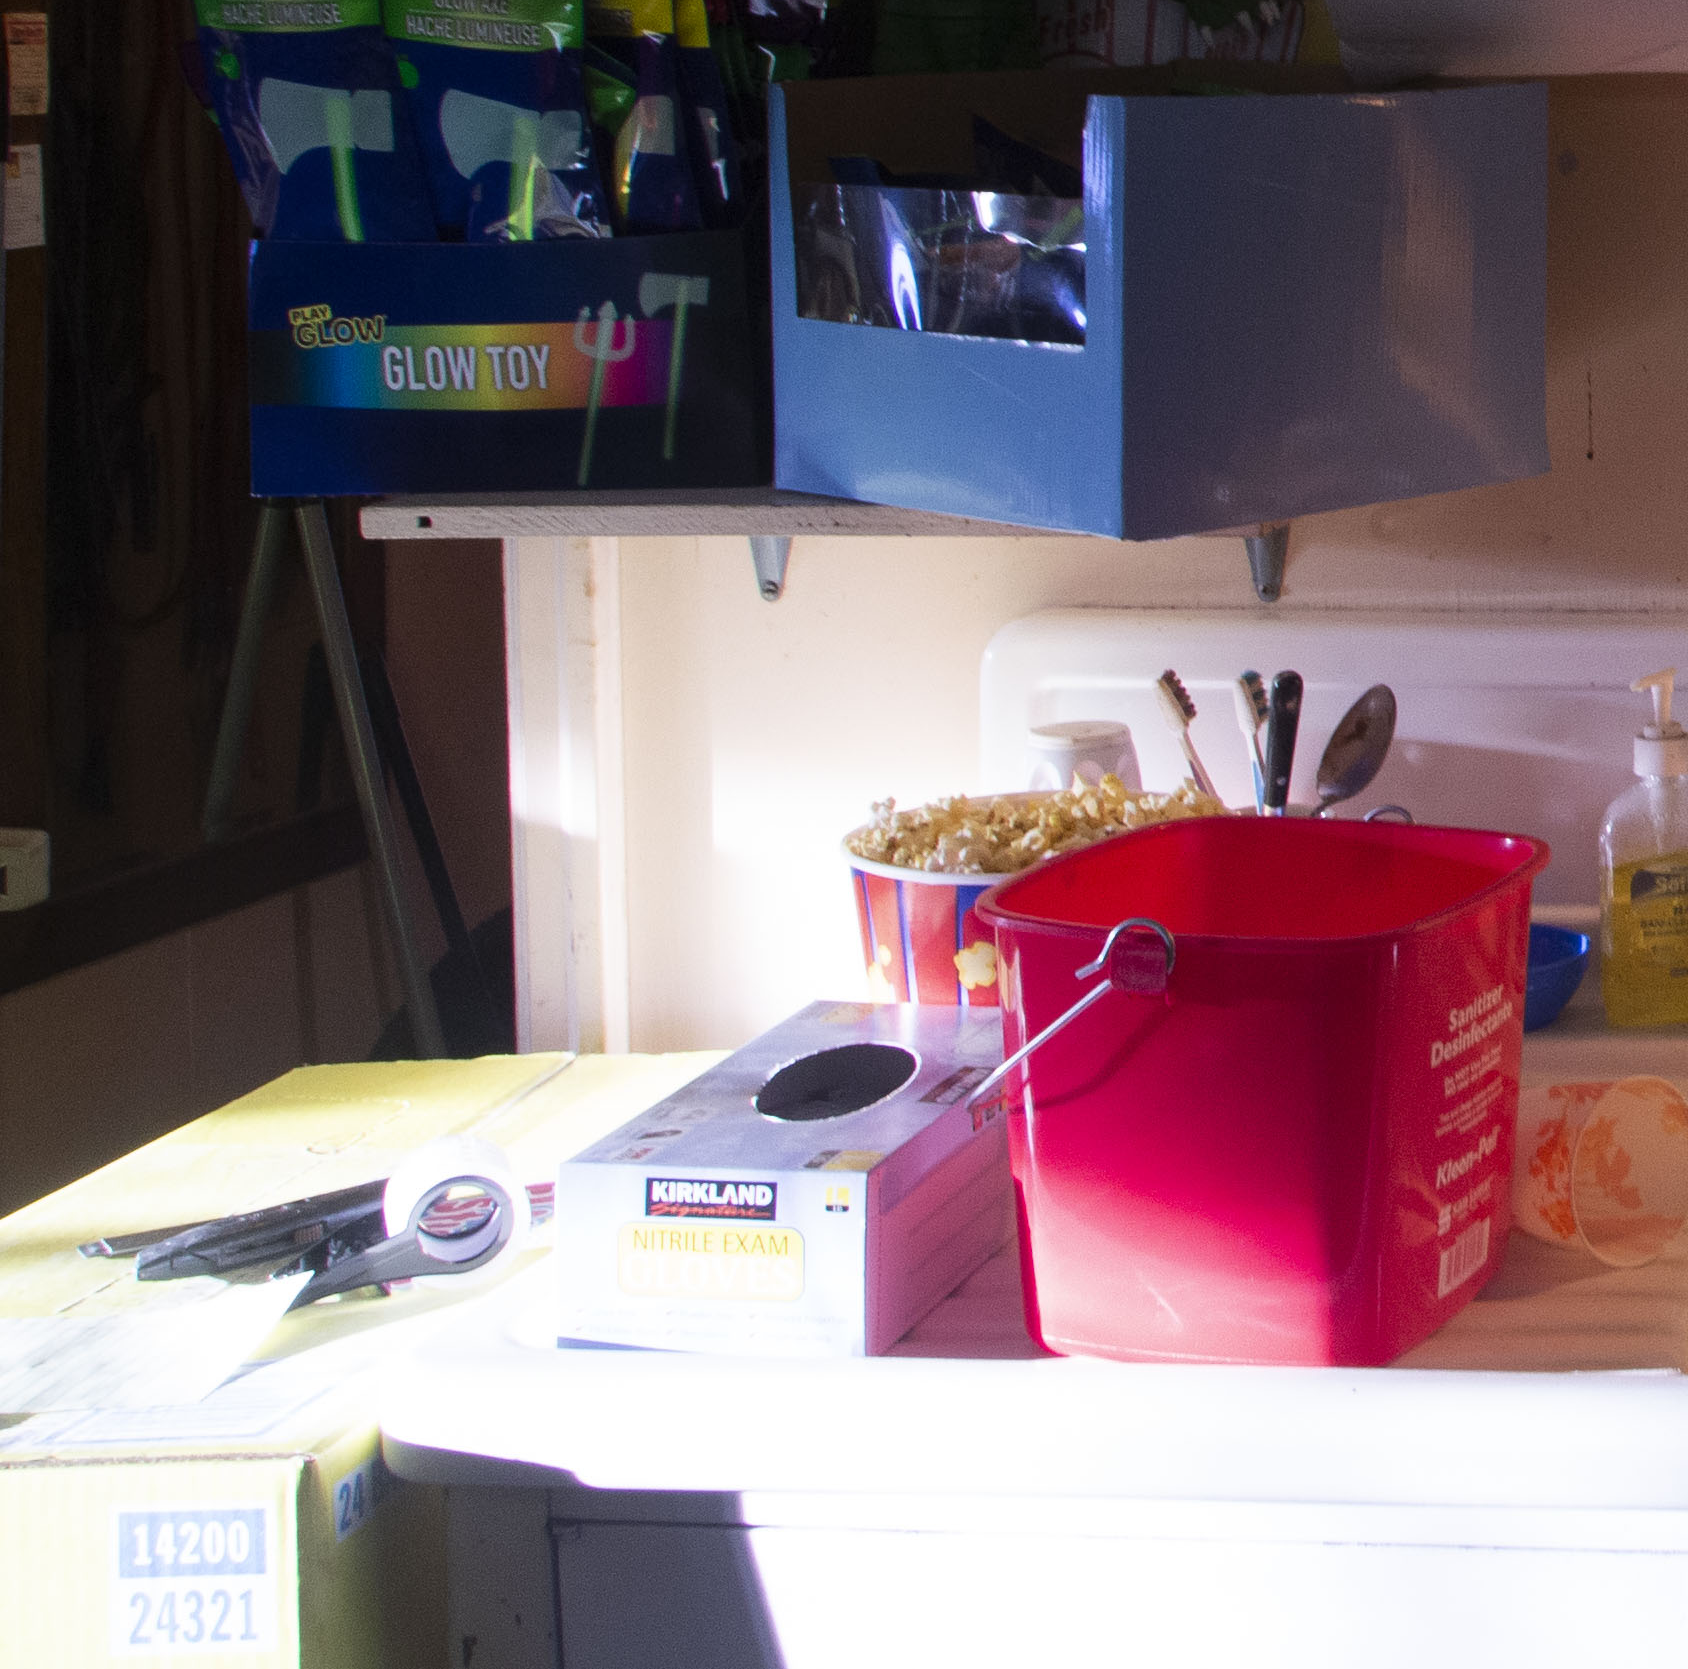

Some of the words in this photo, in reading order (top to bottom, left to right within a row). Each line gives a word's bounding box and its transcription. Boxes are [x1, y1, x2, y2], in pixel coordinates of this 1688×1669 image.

[222, 2, 263, 25] HACHE
[266, 1, 343, 26] LUMINEUSE
[406, 14, 453, 39] HACHE
[456, 20, 541, 47] LUMINEUSE
[291, 306, 329, 321] PLAY
[294, 315, 386, 349] GLOW
[382, 344, 477, 392] GLOW
[485, 344, 550, 392] TOY
[1449, 983, 1504, 1033] Sanitizer
[651, 1180, 773, 1207] KIRKLAND
[649, 1202, 772, 1220] Signature
[632, 1228, 715, 1254] NITRILE
[722, 1232, 790, 1256] EXAM
[133, 1519, 251, 1569] 14200
[128, 1588, 260, 1648] 24321
